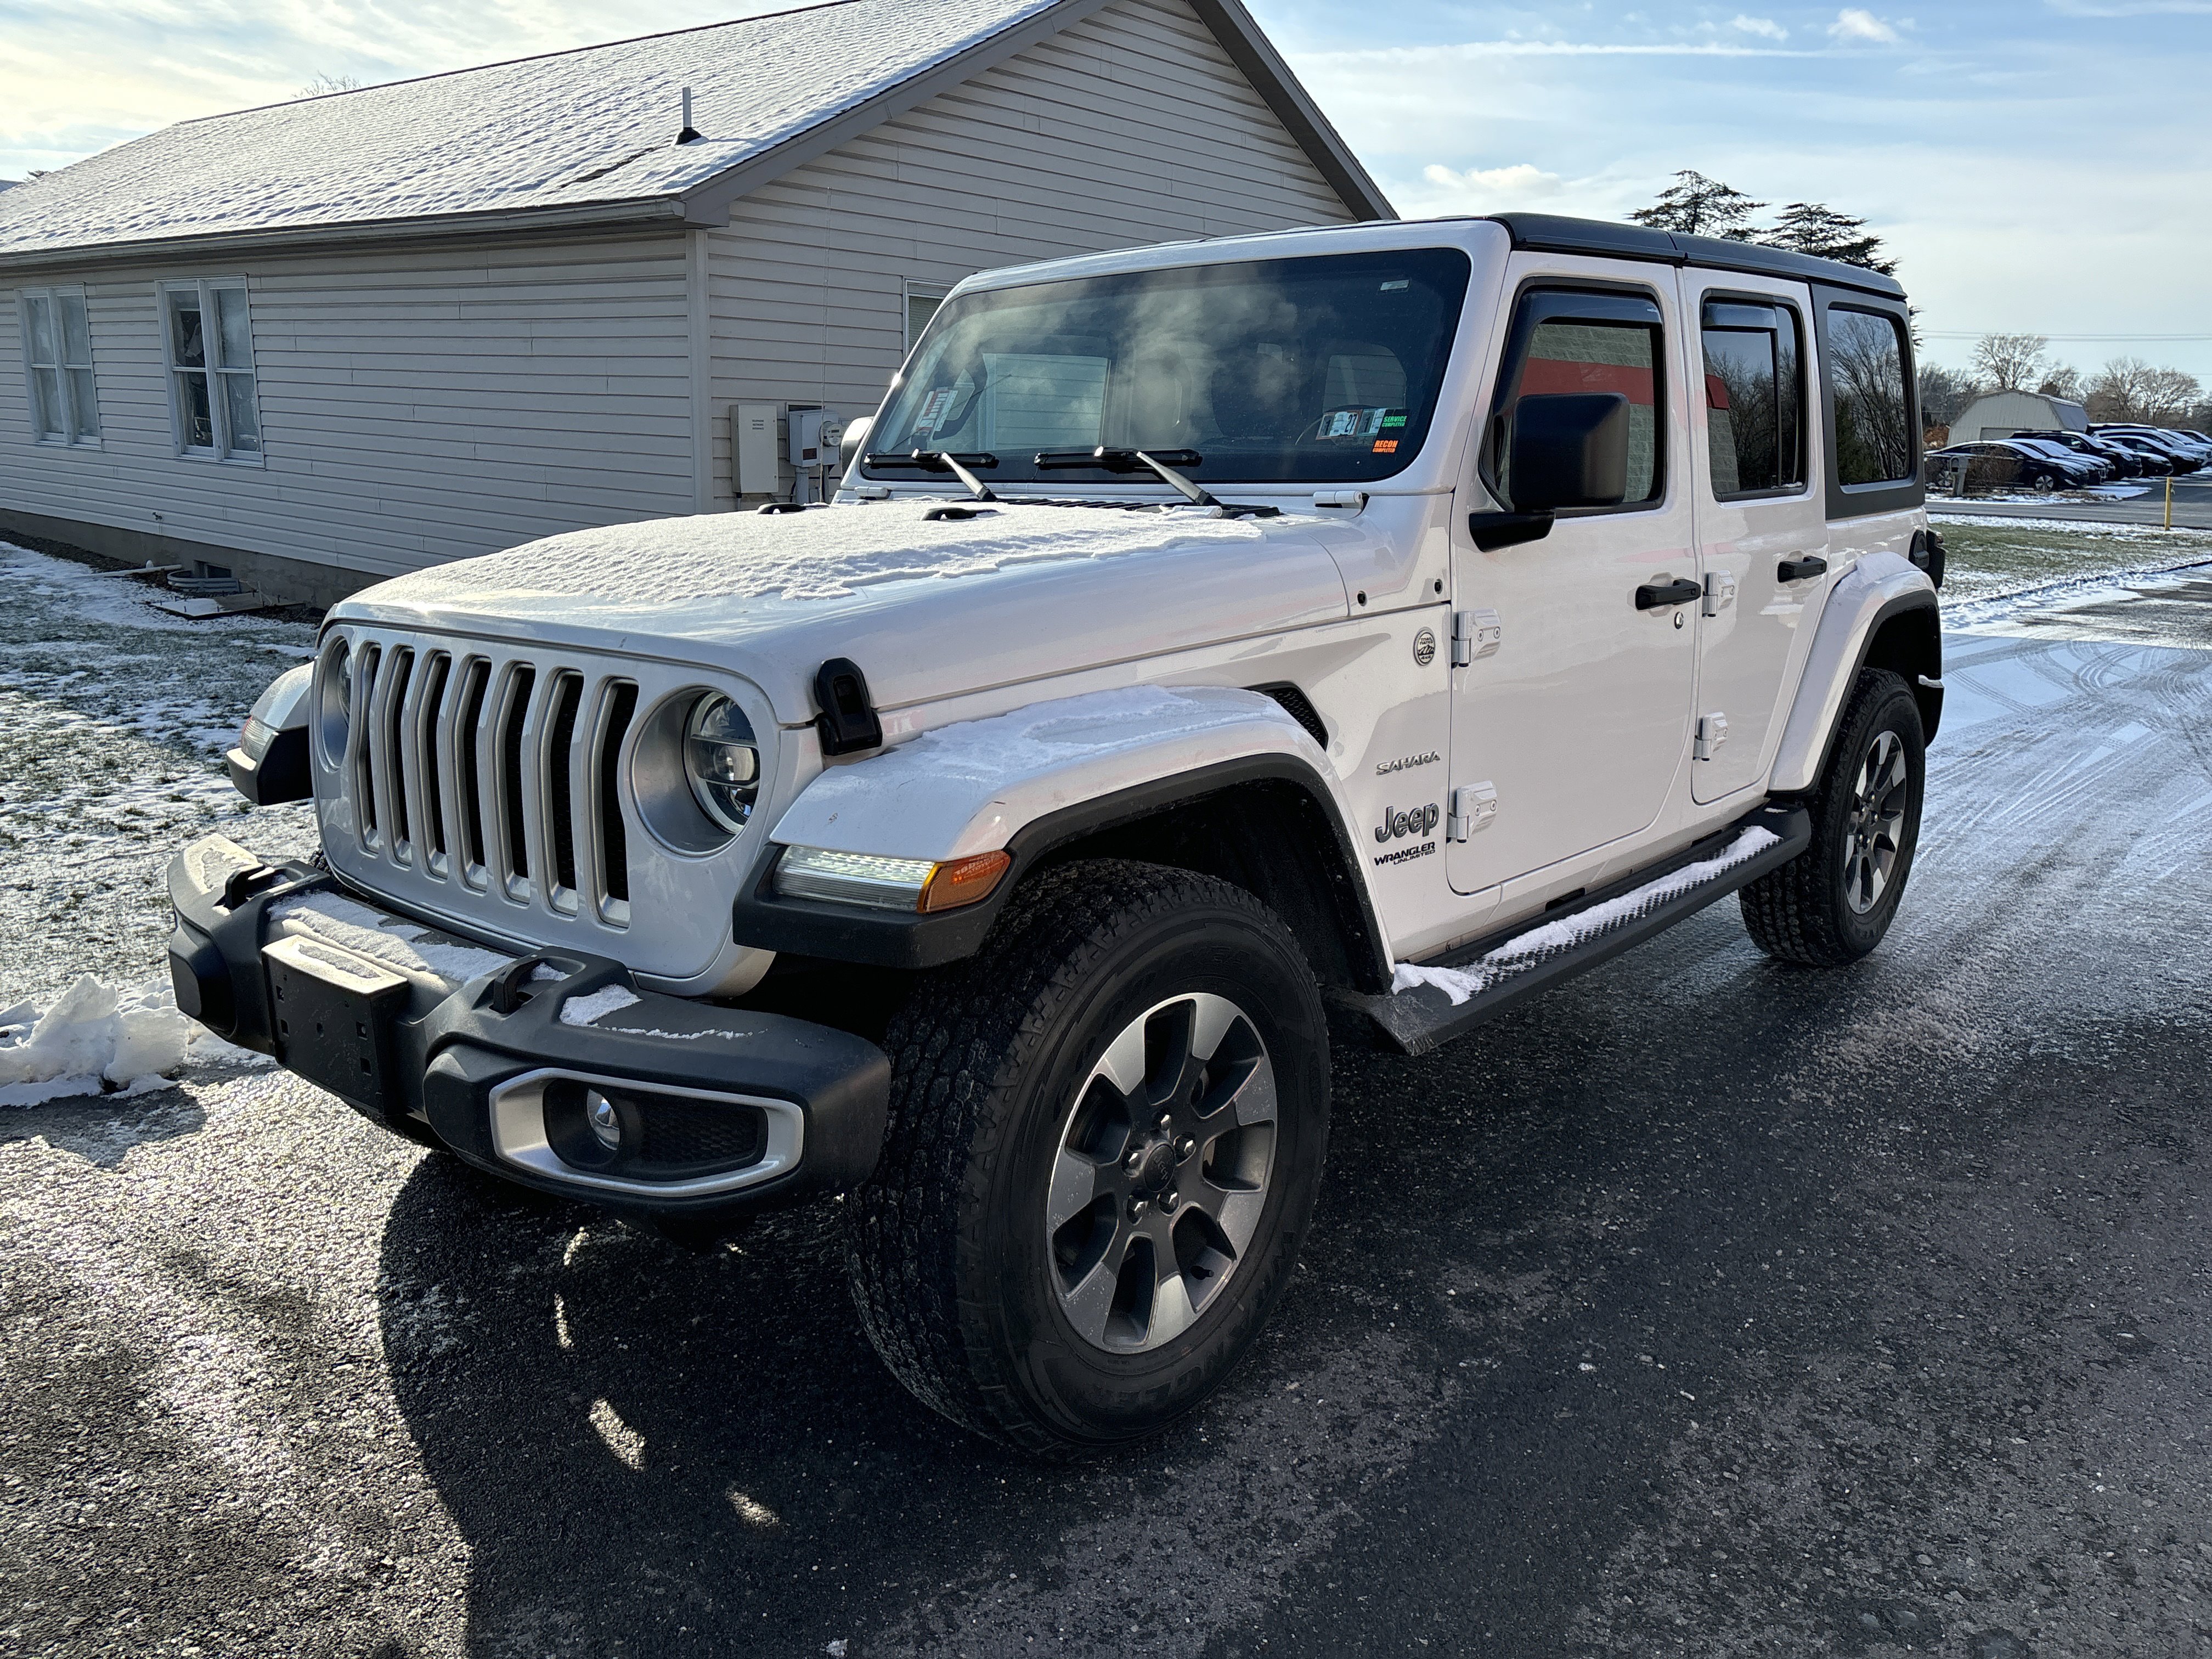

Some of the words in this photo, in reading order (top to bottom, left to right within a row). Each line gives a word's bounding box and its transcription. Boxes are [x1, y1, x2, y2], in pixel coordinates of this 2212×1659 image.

[1344, 414, 1358, 435] 27
[1376, 751, 1441, 775] SAHARA
[1375, 802, 1440, 843] Jeep
[1374, 841, 1436, 866] WRANGLER
[1393, 849, 1436, 865] UNLIMITED
